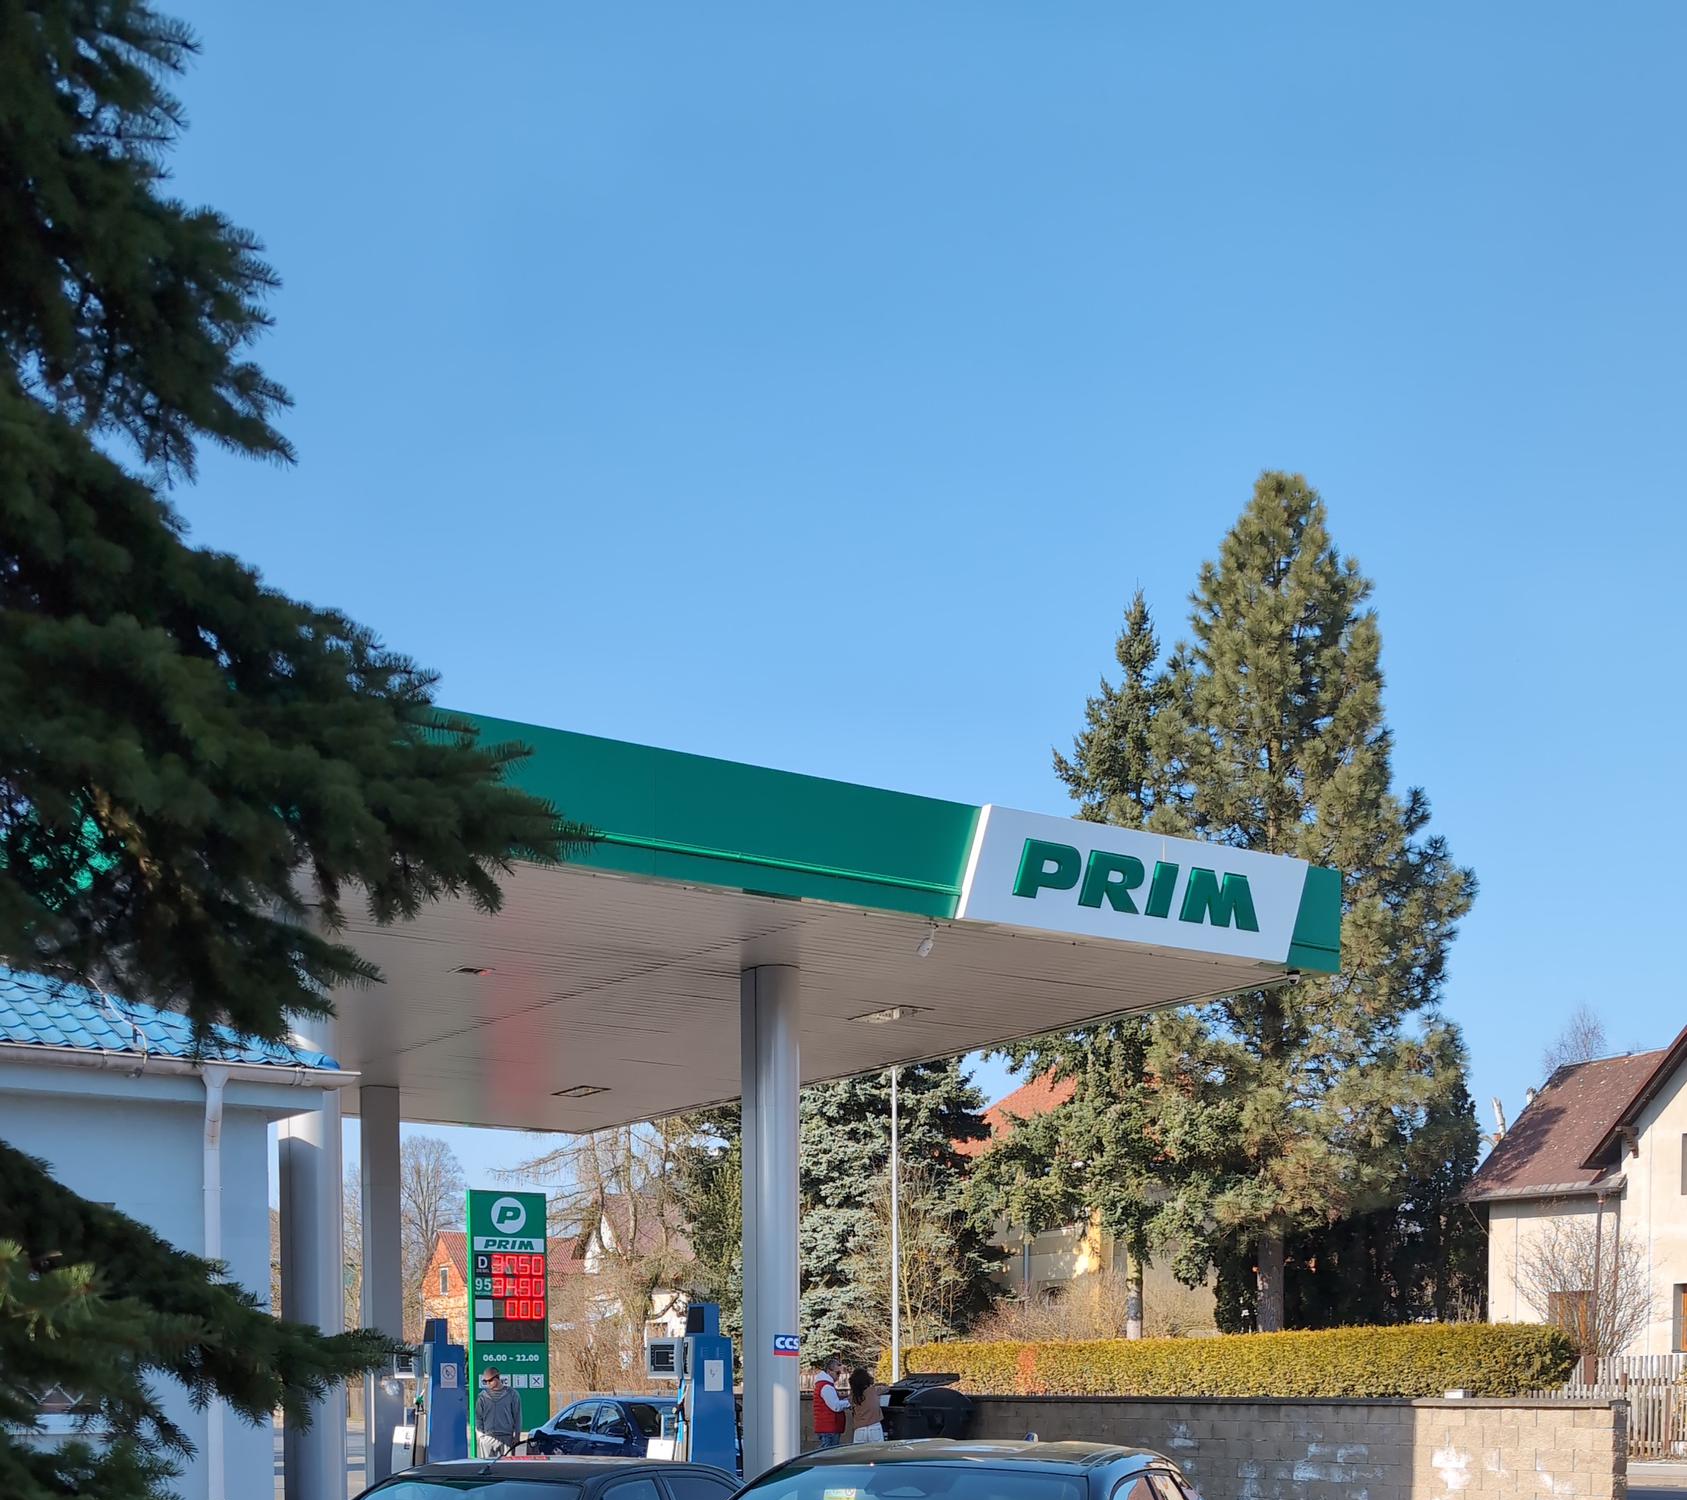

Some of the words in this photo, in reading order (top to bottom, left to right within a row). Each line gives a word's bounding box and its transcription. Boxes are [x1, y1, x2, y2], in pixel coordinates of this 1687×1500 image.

[1011, 837, 1260, 933] PRIM
[496, 1206, 521, 1224] P
[483, 1239, 535, 1250] PRIM
[477, 1255, 488, 1269] D
[475, 1277, 492, 1291] 95
[775, 1337, 799, 1349] CCS
[482, 1354, 508, 1362] 06.00
[515, 1354, 540, 1362] 22.00
